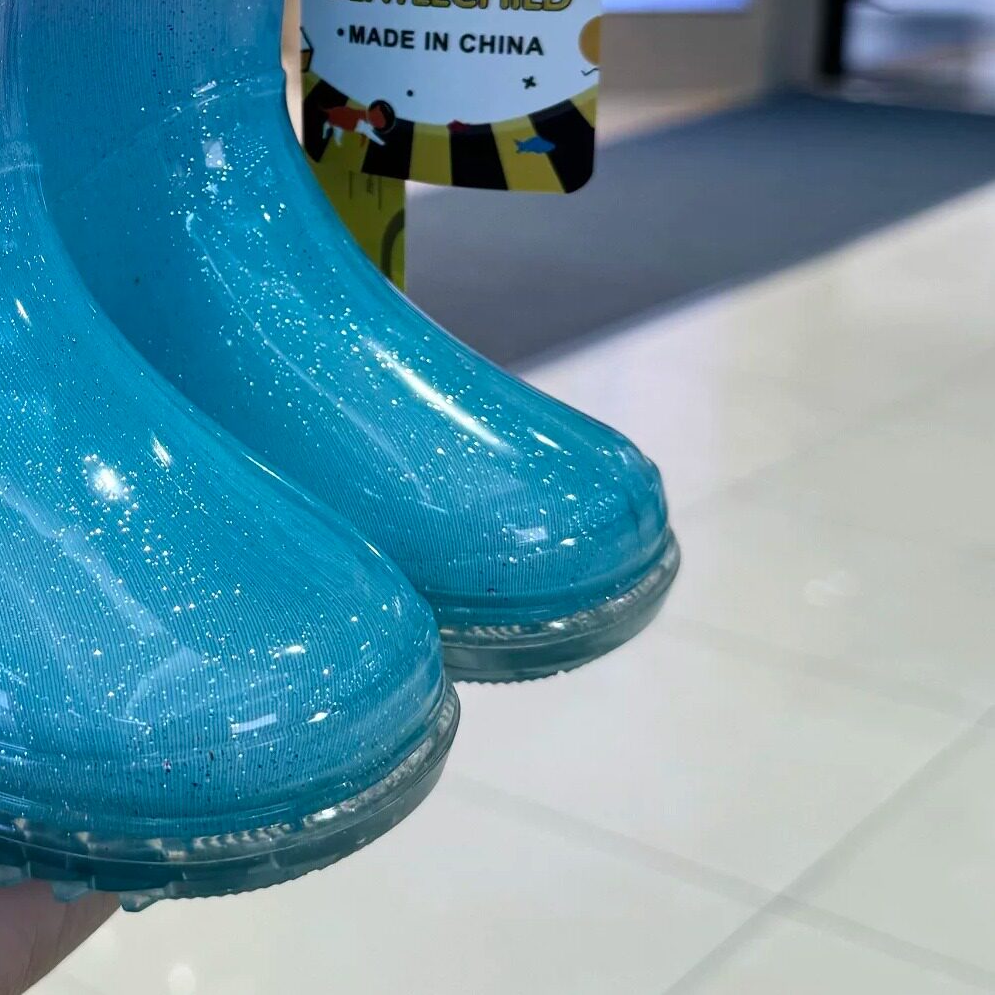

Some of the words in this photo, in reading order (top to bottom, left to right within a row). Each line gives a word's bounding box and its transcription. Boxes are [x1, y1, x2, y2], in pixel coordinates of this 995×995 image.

[349, 24, 415, 50] MADE
[424, 31, 449, 52] IN
[459, 33, 545, 56] CHINA
